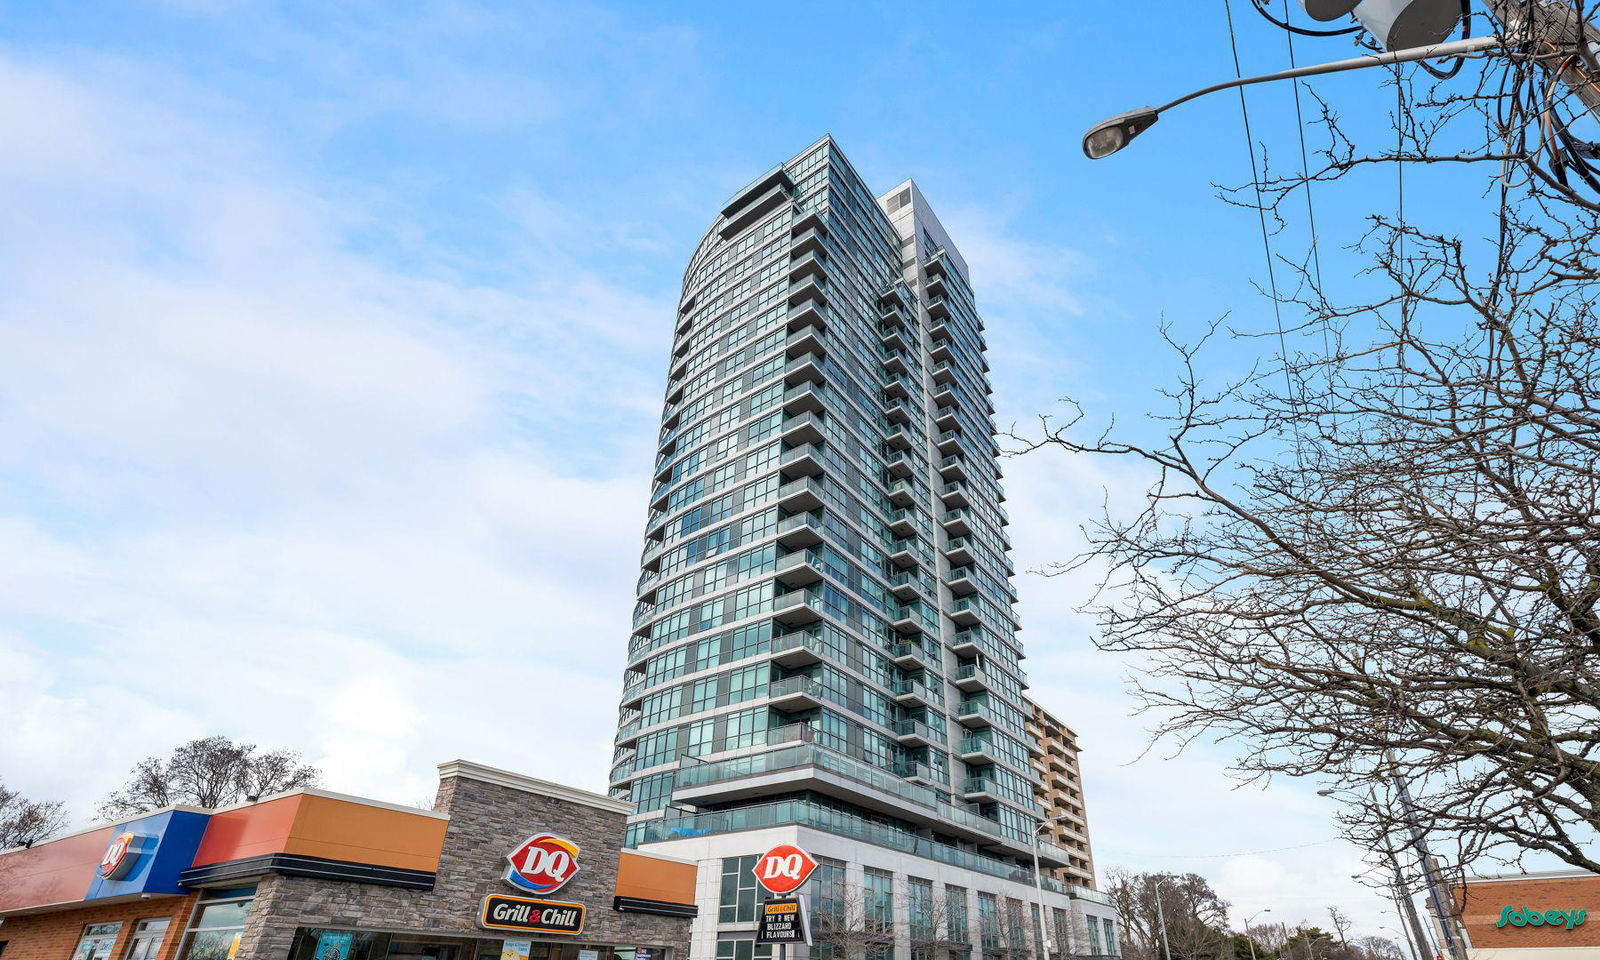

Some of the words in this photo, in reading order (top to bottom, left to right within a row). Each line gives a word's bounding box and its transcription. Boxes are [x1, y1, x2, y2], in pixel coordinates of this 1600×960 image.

[521, 846, 570, 882] DQ
[763, 854, 803, 880] DQ
[767, 923, 792, 931] BLIZZARD
[1496, 905, 1587, 930] Sobeys
